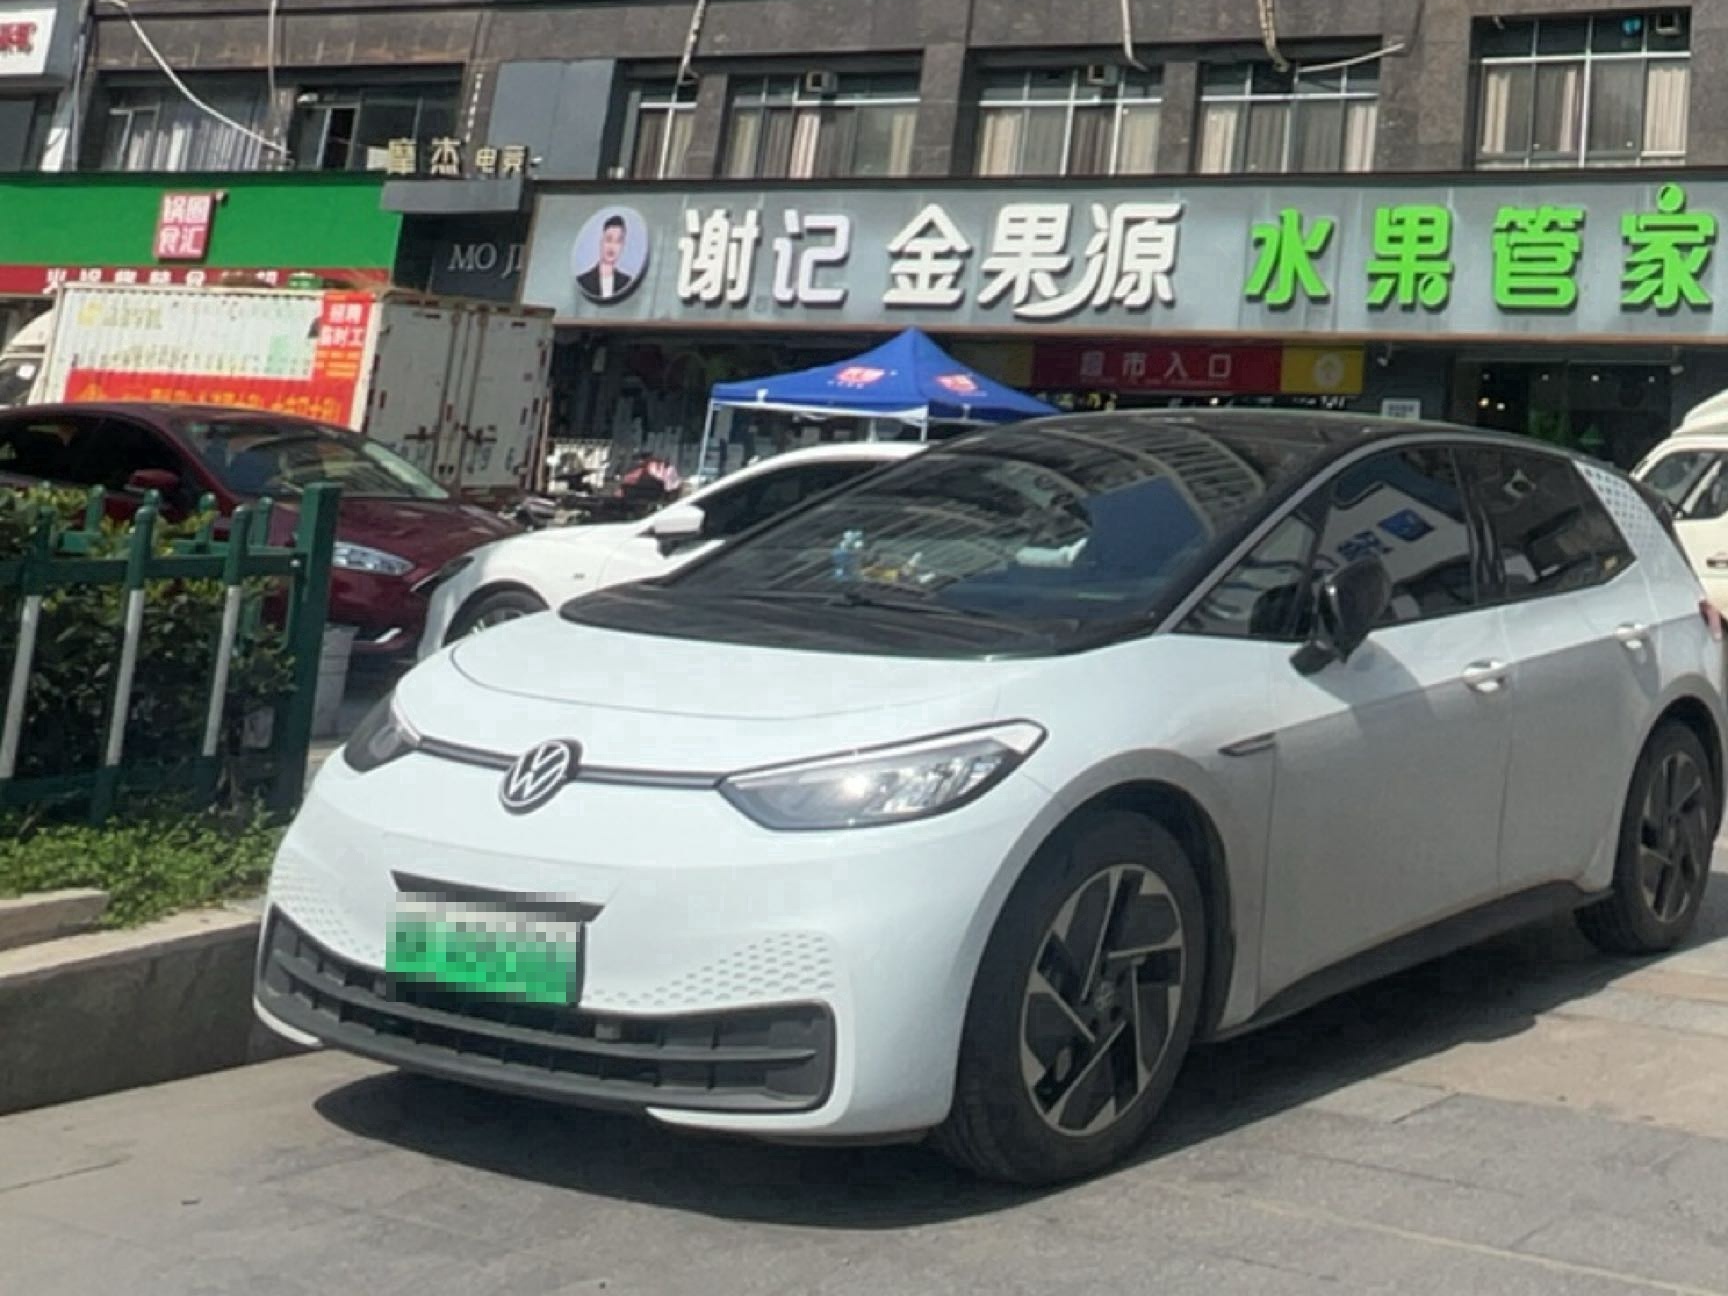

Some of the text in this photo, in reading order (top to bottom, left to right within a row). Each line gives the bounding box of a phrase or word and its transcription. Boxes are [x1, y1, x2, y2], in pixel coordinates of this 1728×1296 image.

[448, 243, 498, 271] MO
[677, 183, 1718, 319] 谢记 金果源 水果管家
